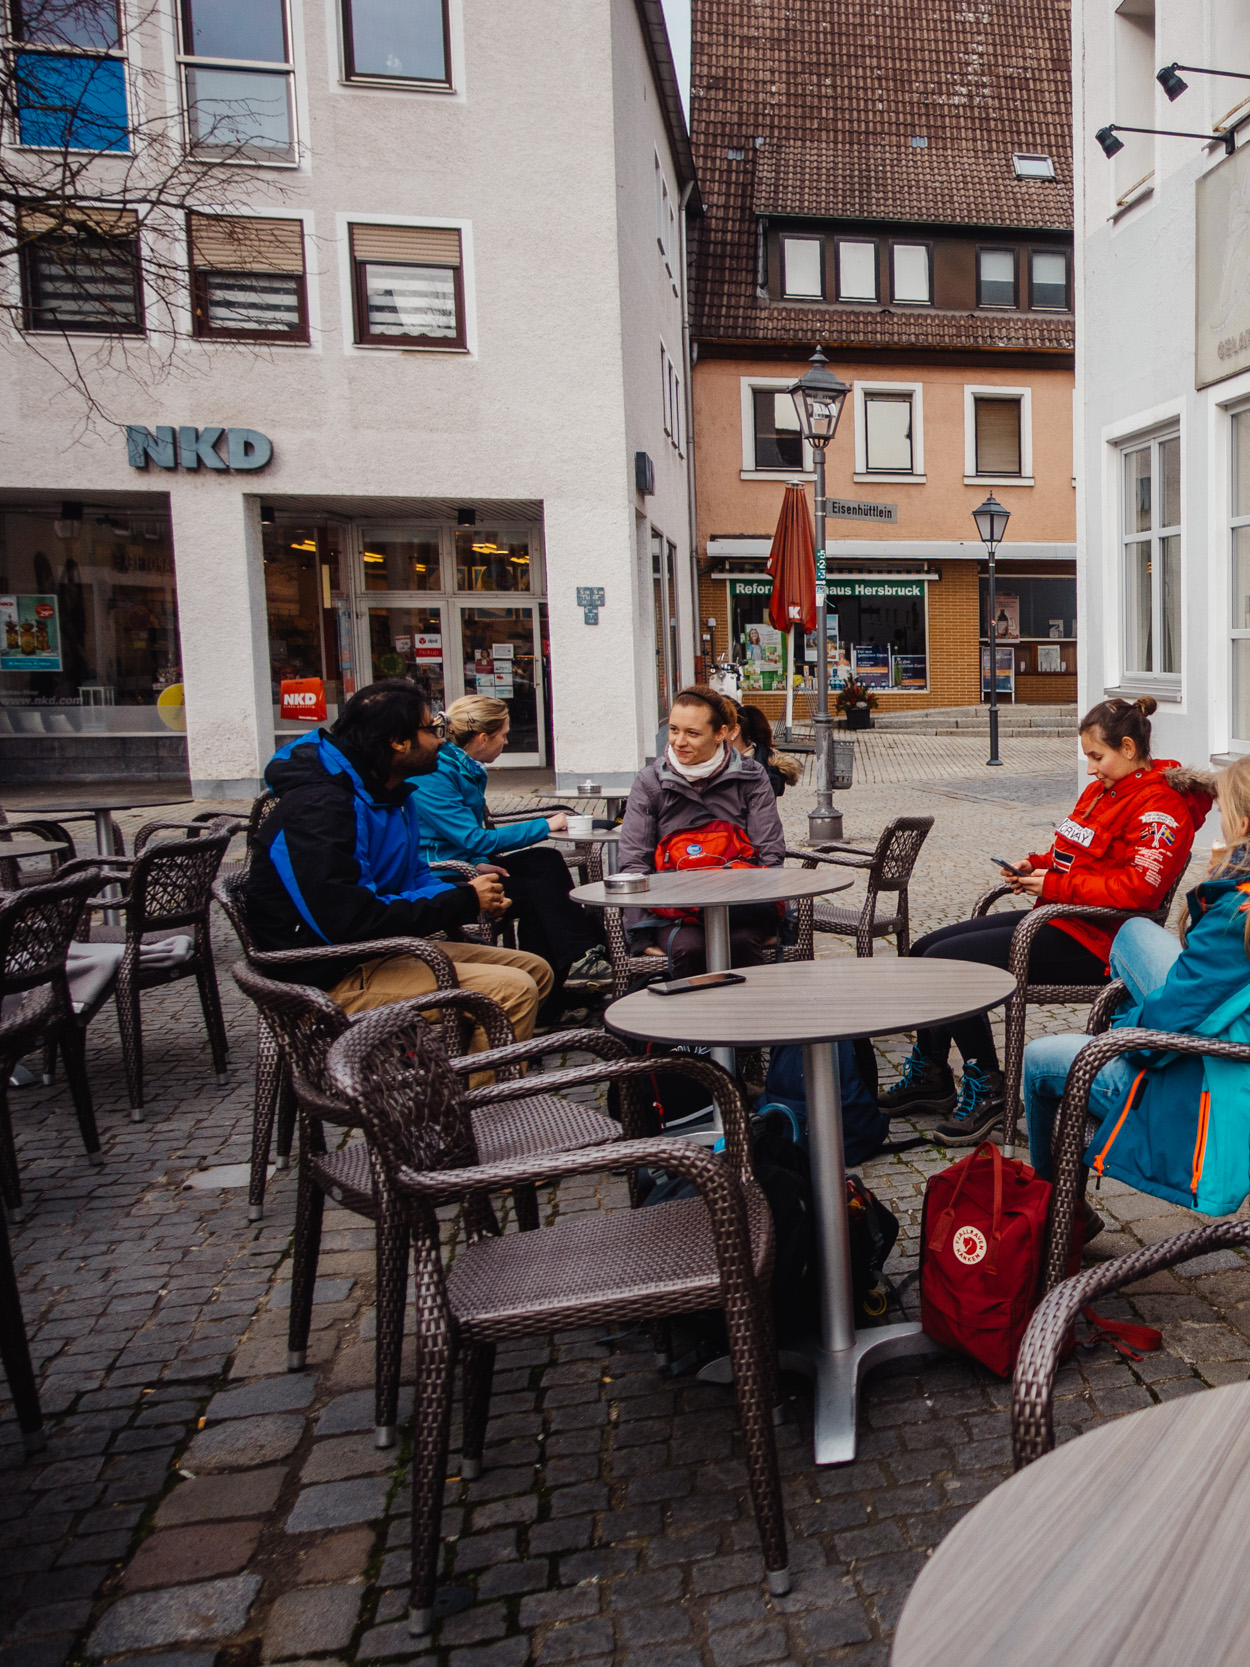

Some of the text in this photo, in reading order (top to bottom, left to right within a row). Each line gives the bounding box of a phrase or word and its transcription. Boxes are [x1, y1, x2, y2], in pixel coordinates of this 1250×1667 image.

[126, 425, 274, 471] NKD
[832, 501, 893, 519] Eisenhüttlein
[735, 583, 773, 594] Refor
[855, 585, 921, 596] Hersbruck
[788, 606, 801, 619] K
[283, 692, 317, 705] NKD
